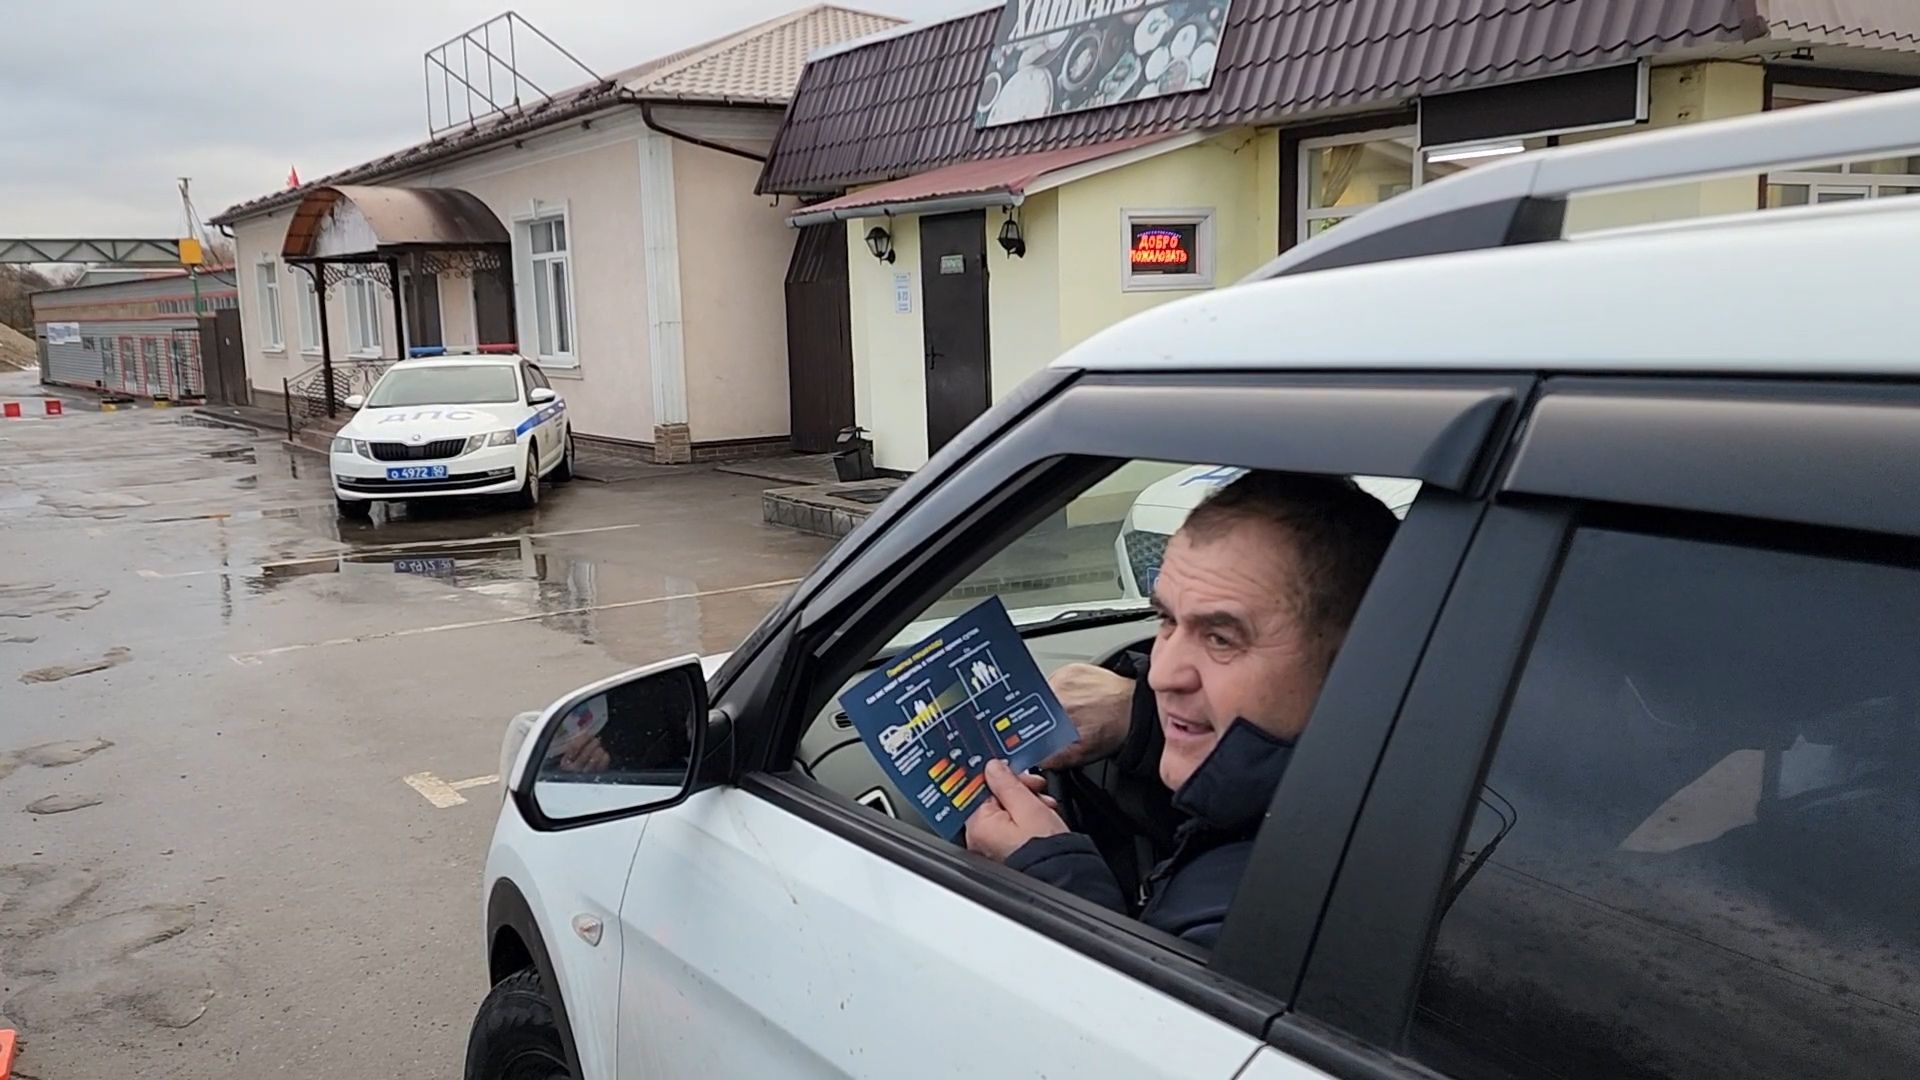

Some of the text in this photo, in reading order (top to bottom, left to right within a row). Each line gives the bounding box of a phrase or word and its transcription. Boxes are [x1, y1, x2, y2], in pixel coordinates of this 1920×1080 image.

[1139, 235, 1179, 249] ДОБРО
[1130, 249, 1188, 263] ПОЖАЛОВАТЬ
[378, 411, 475, 424] ДПС
[402, 467, 428, 478] 4972
